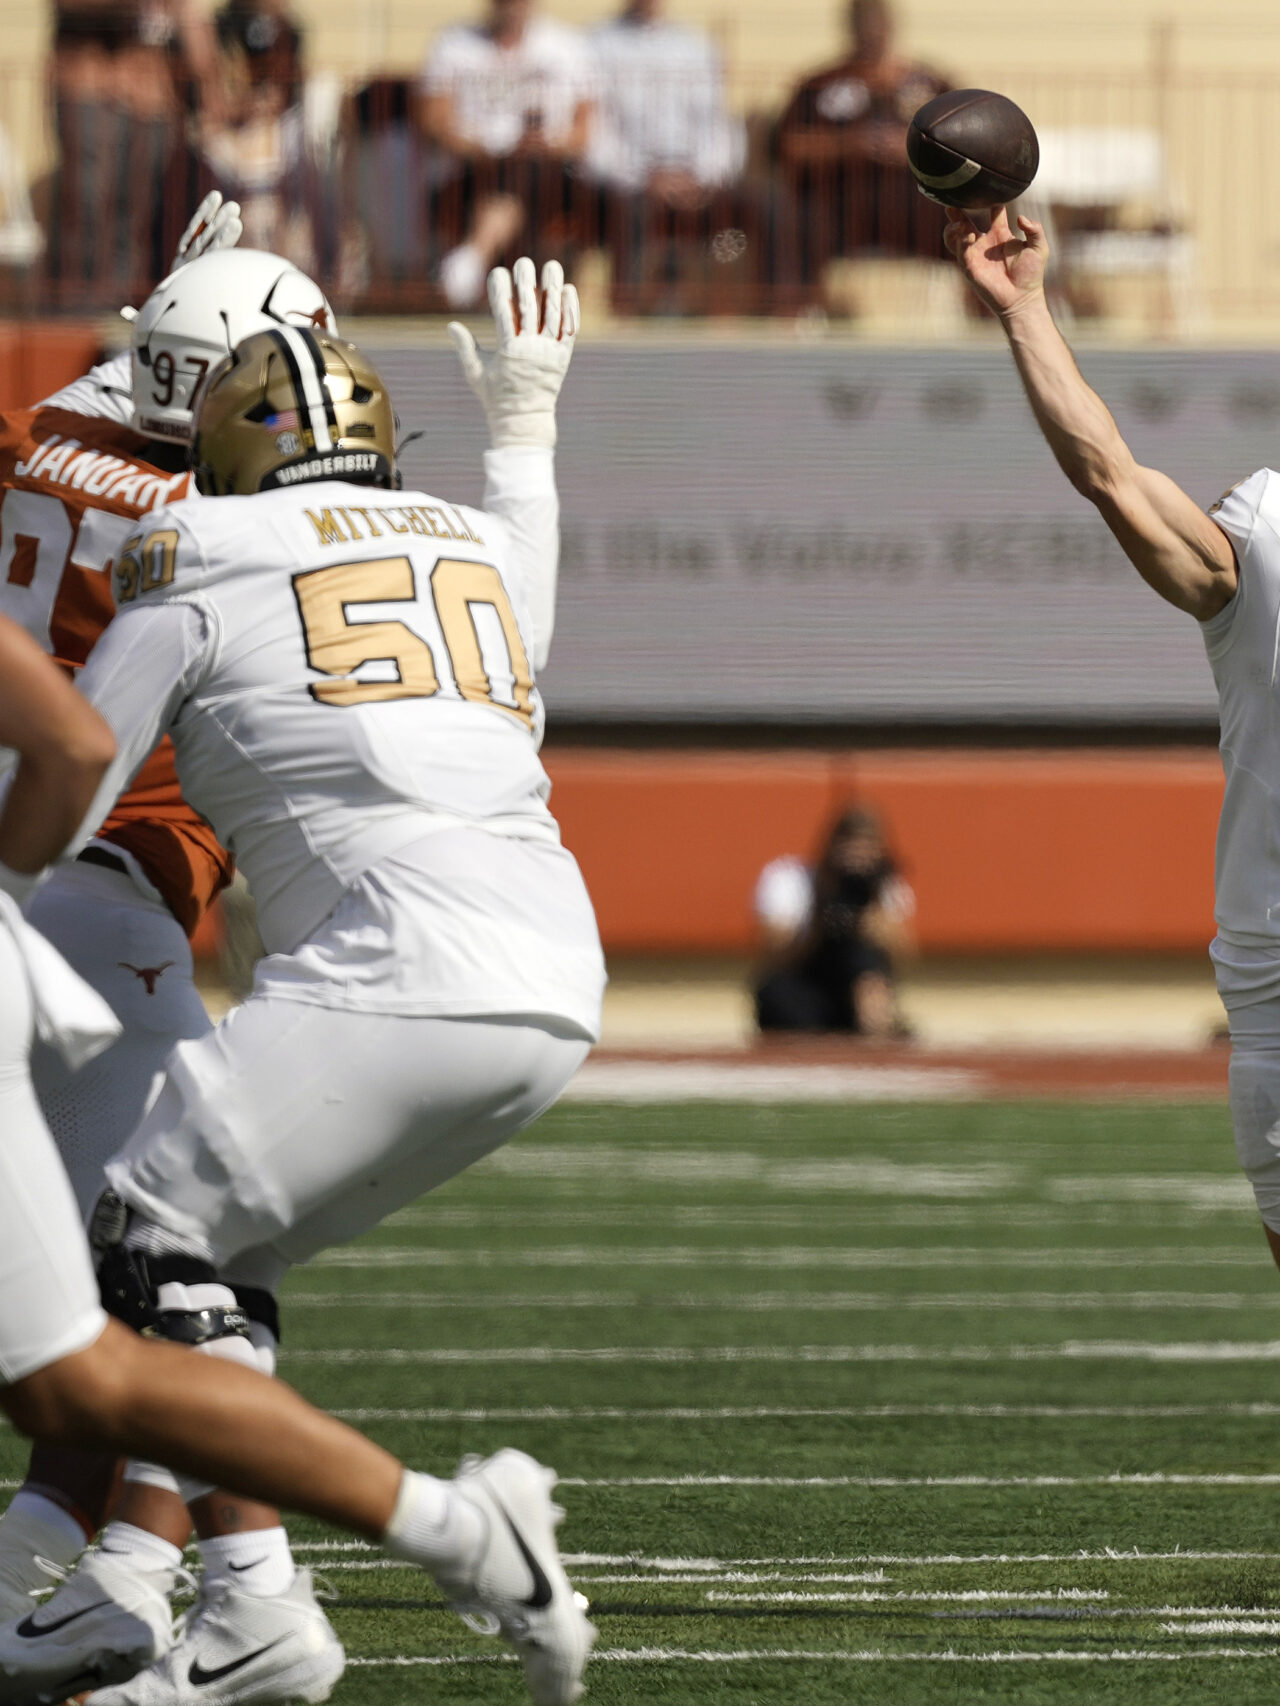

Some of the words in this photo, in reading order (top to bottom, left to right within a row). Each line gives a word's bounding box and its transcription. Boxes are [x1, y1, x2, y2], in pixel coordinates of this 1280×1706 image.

[152, 351, 209, 410] 97
[275, 454, 379, 485] VANDERBILT
[304, 507, 484, 545] MITCHELL
[291, 555, 534, 732] 50
